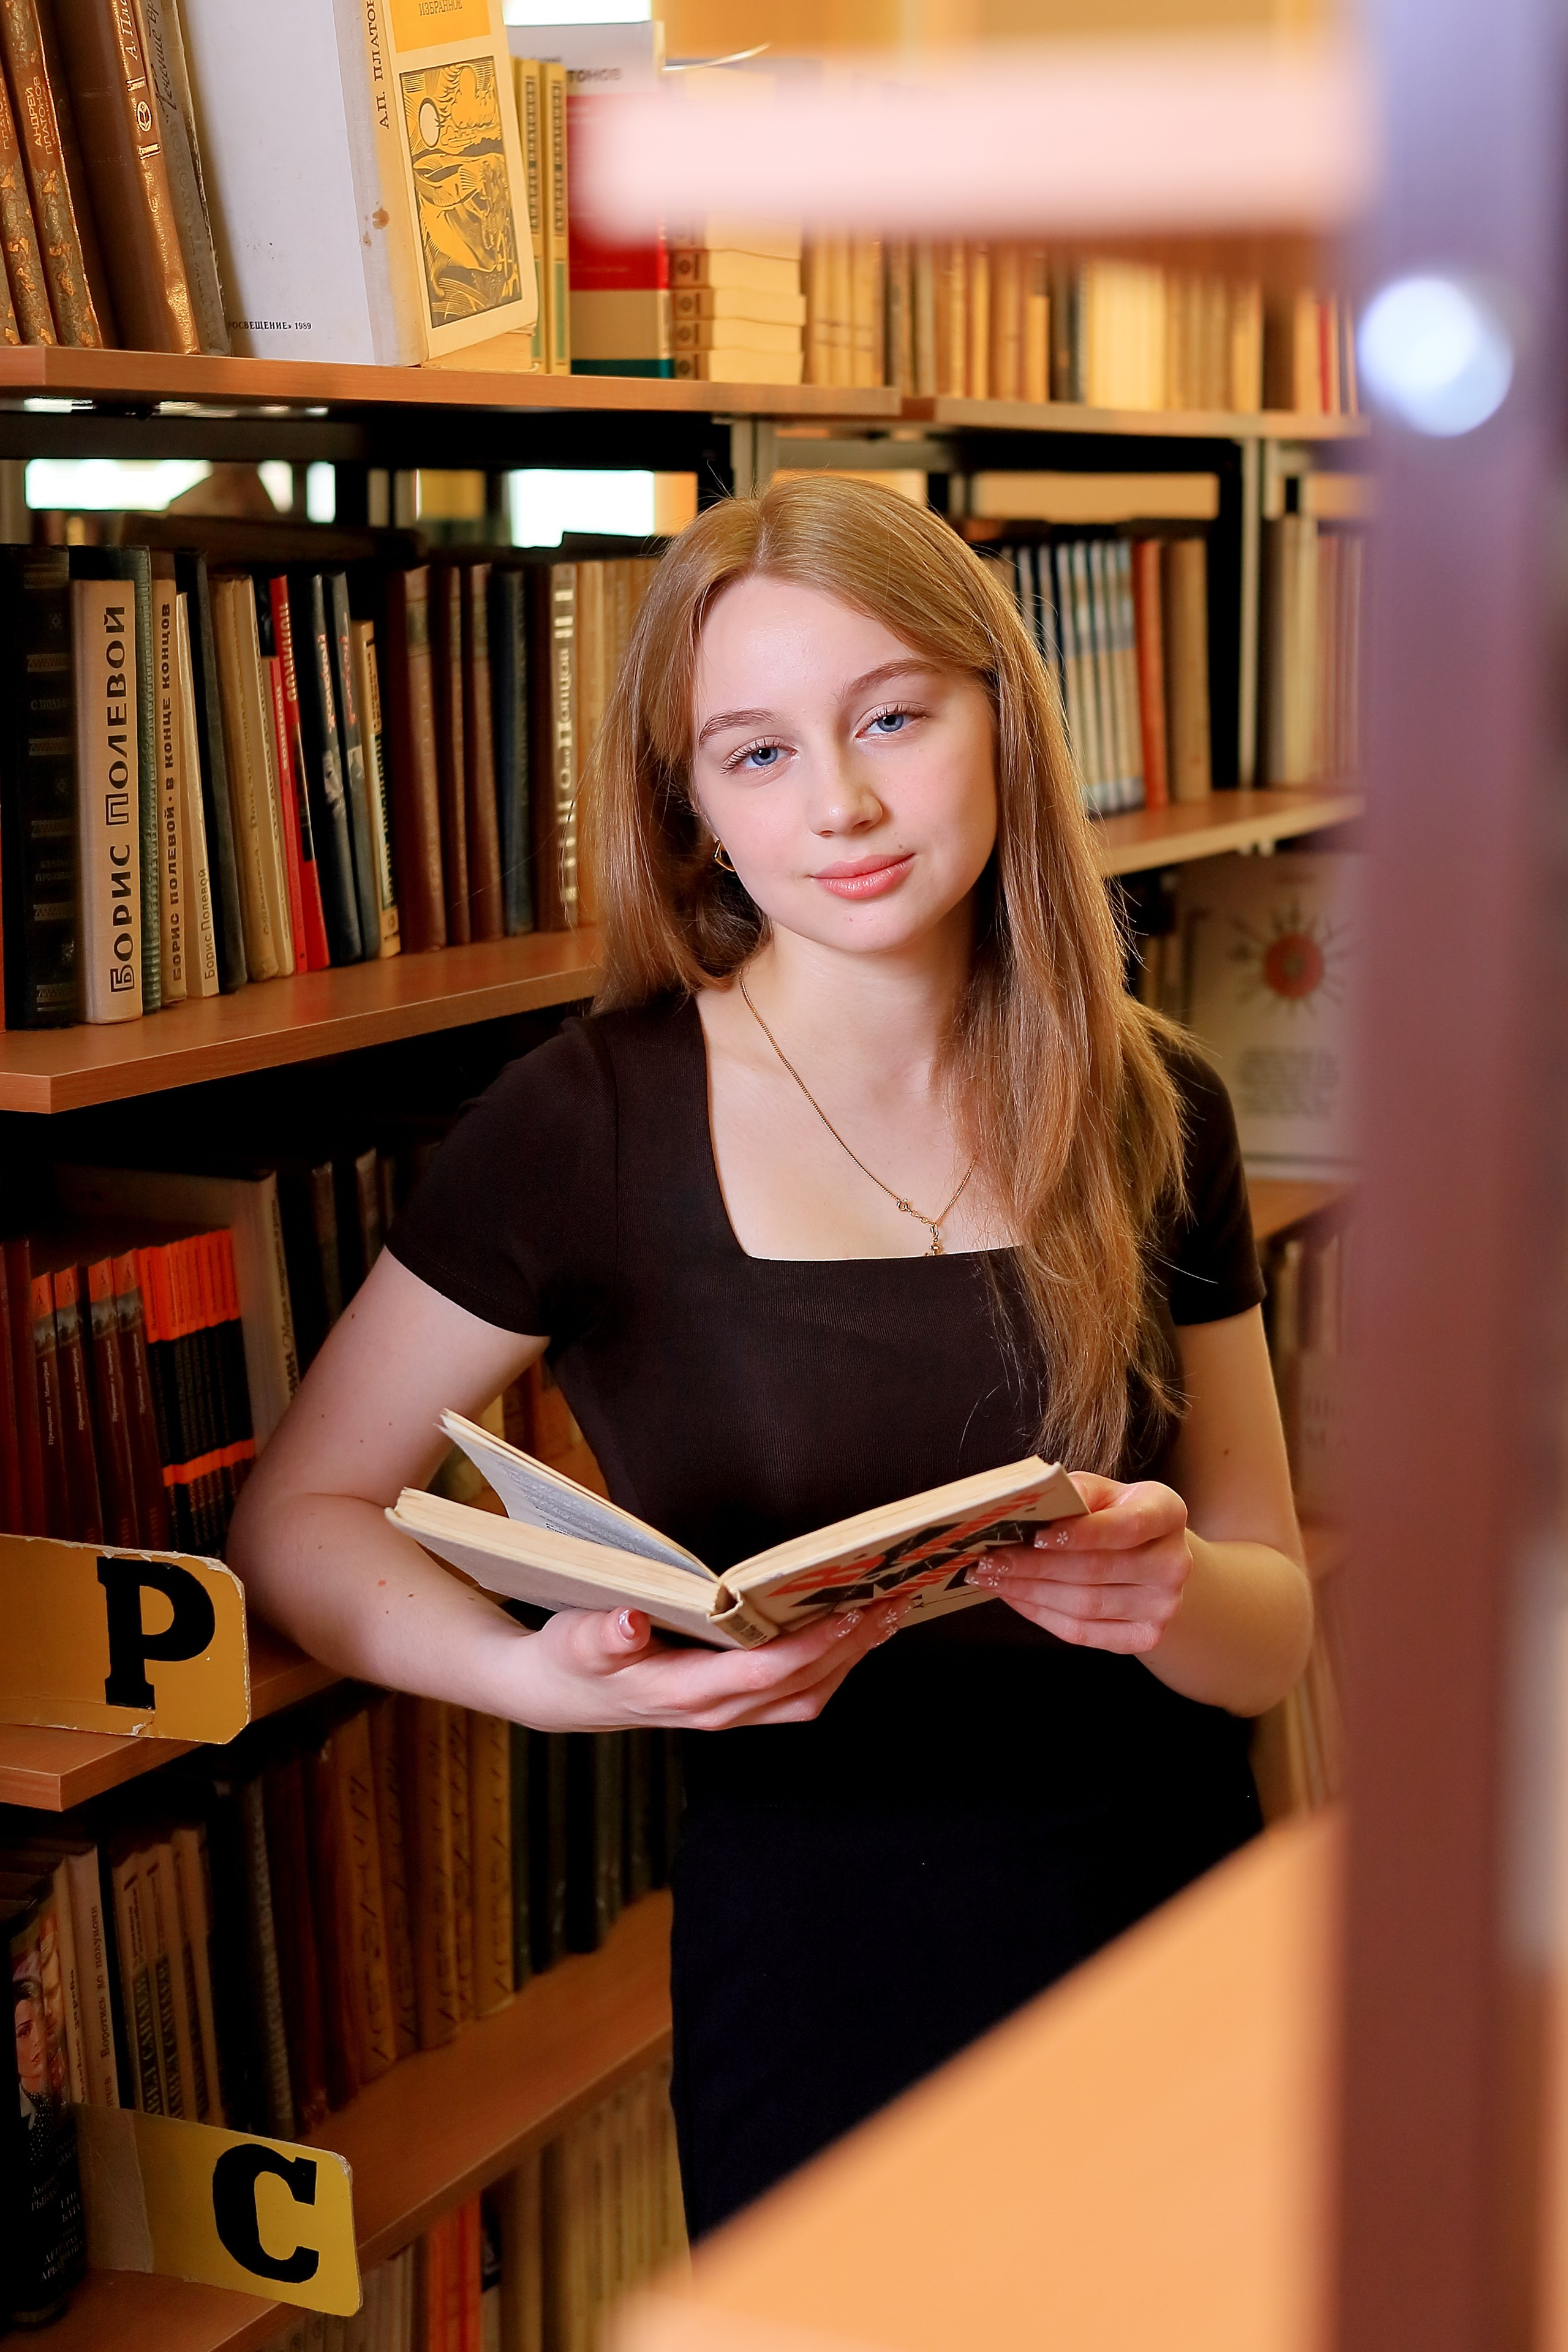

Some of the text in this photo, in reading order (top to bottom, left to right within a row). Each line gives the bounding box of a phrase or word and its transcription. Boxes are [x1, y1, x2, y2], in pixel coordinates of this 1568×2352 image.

[25, 87, 42, 147] АНДРЕЙ
[33, 76, 53, 154] ПЛАТОНОВ
[294, 322, 312, 330] 1989
[160, 603, 171, 690] КОНЦОВ
[162, 697, 173, 767] КОНЦЕ
[165, 805, 178, 905] ПОЛЕВОЙ
[170, 913, 183, 982] БОРИС
[198, 869, 216, 981] Борис Полевой
[97, 1556, 216, 1709] Р
[91, 1905, 103, 1969] полуночи
[97, 1973, 106, 1991] до
[97, 1997, 111, 2059] Воротись
[212, 2143, 320, 2285] С
